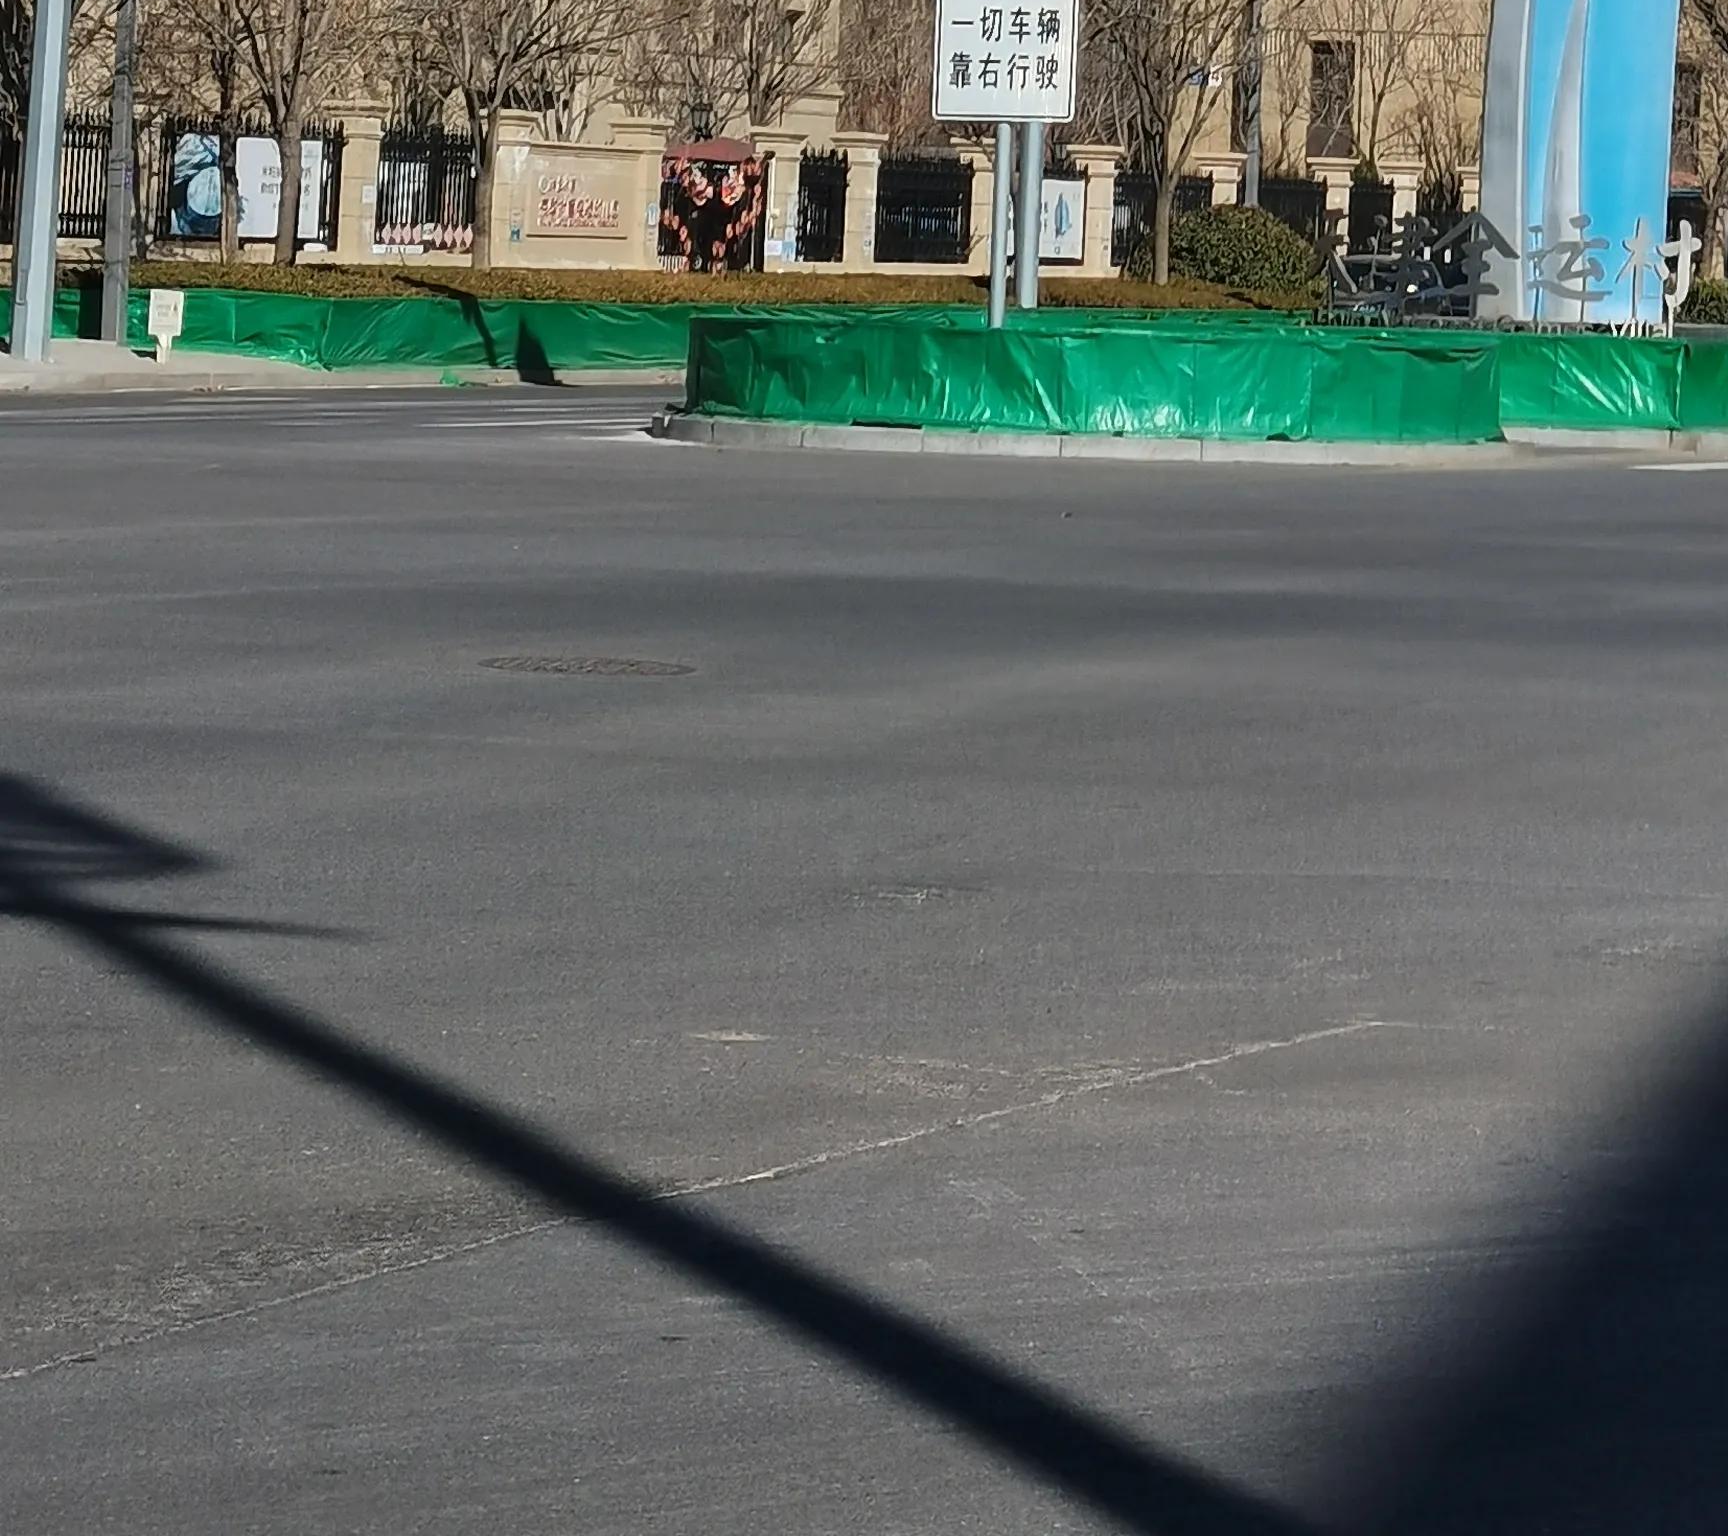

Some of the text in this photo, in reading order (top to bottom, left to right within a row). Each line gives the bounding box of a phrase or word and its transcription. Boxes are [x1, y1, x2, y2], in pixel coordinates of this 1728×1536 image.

[951, 6, 1060, 44] 一切车辆
[949, 51, 1059, 90] 靠右行驶
